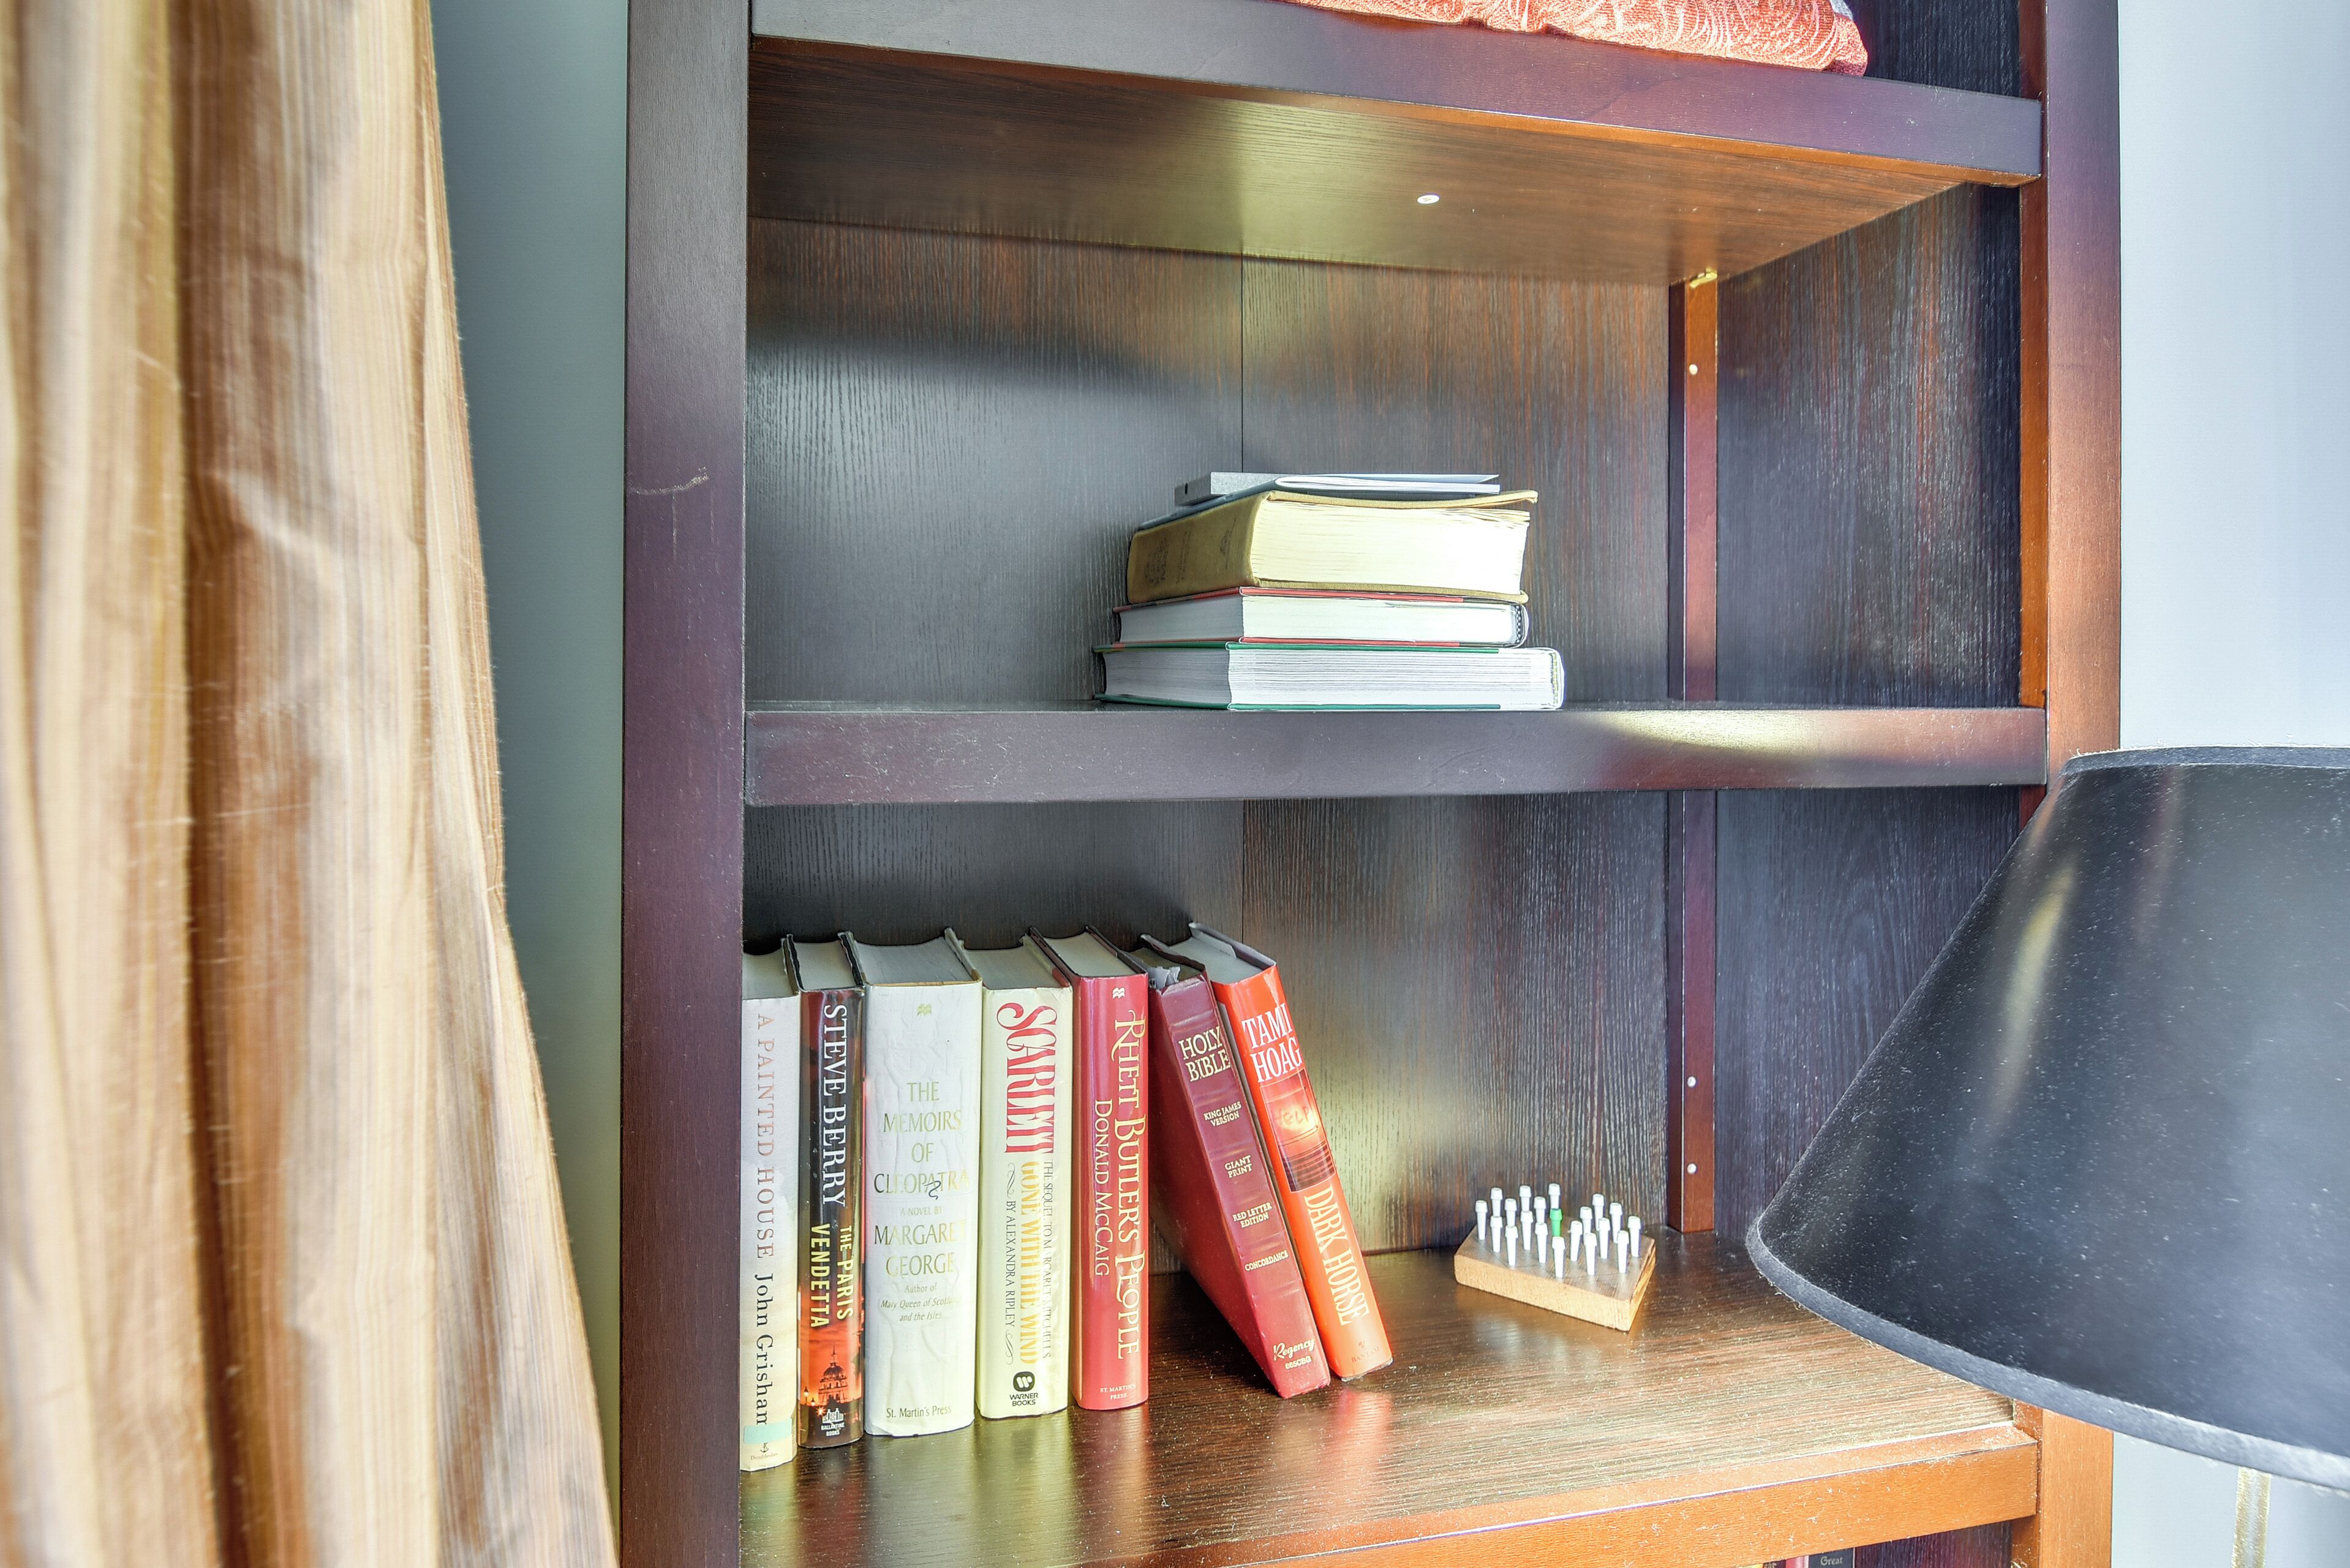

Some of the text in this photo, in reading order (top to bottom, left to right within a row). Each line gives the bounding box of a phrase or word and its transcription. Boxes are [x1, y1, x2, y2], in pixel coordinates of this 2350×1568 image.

[1241, 1003, 1294, 1049] TAMI
[1178, 1026, 1223, 1060] HOLY
[1186, 1048, 1231, 1082] BIBLE
[1250, 1036, 1303, 1083] HOAG
[996, 1002, 1058, 1153] SCARLETT
[906, 1082, 940, 1102] THE
[823, 1005, 848, 1207] STEVE BERRY
[1203, 1101, 1242, 1121] KING JAMES
[883, 1110, 962, 1133] MEMOIRS
[1210, 1110, 1240, 1128] VERSION
[756, 1014, 775, 1259] A PAINTED HOUSE
[1094, 1098, 1113, 1185] DONALD
[911, 1142, 934, 1163] OF
[1224, 1155, 1251, 1171] GIANT
[874, 1169, 970, 1195] CLEOPATRA
[1227, 1164, 1252, 1178] PRINT
[1111, 1009, 1146, 1360] RHETT BUTLER'S PEOPLE
[908, 1207, 931, 1216] NOVEL
[1232, 1202, 1272, 1222] RED LETTER
[1240, 1212, 1270, 1229] EDITION
[886, 1252, 955, 1277] GEORGE
[1005, 1200, 1016, 1327] BY ALEXANDRA RIPLEY
[1020, 1161, 1041, 1365] GONE WITH THE WIND
[1245, 1250, 1289, 1272] CONCORDANCE
[1303, 1184, 1370, 1326] DARK HORSE
[810, 1223, 830, 1328] VENDETTA
[837, 1225, 854, 1321] THE PARIS
[905, 1283, 937, 1294] Author of
[755, 1273, 774, 1327] John
[880, 1299, 897, 1311] Mary
[899, 1299, 921, 1310] Queen
[923, 1297, 932, 1308] of
[899, 1311, 943, 1321] and the Isles
[1273, 1339, 1315, 1361] Regency
[1009, 1392, 1039, 1401] WARNER
[886, 1405, 952, 1418] St. Martin's Press
[821, 1422, 845, 1431] BALLANTINE
[1820, 1556, 1843, 1566] Great
